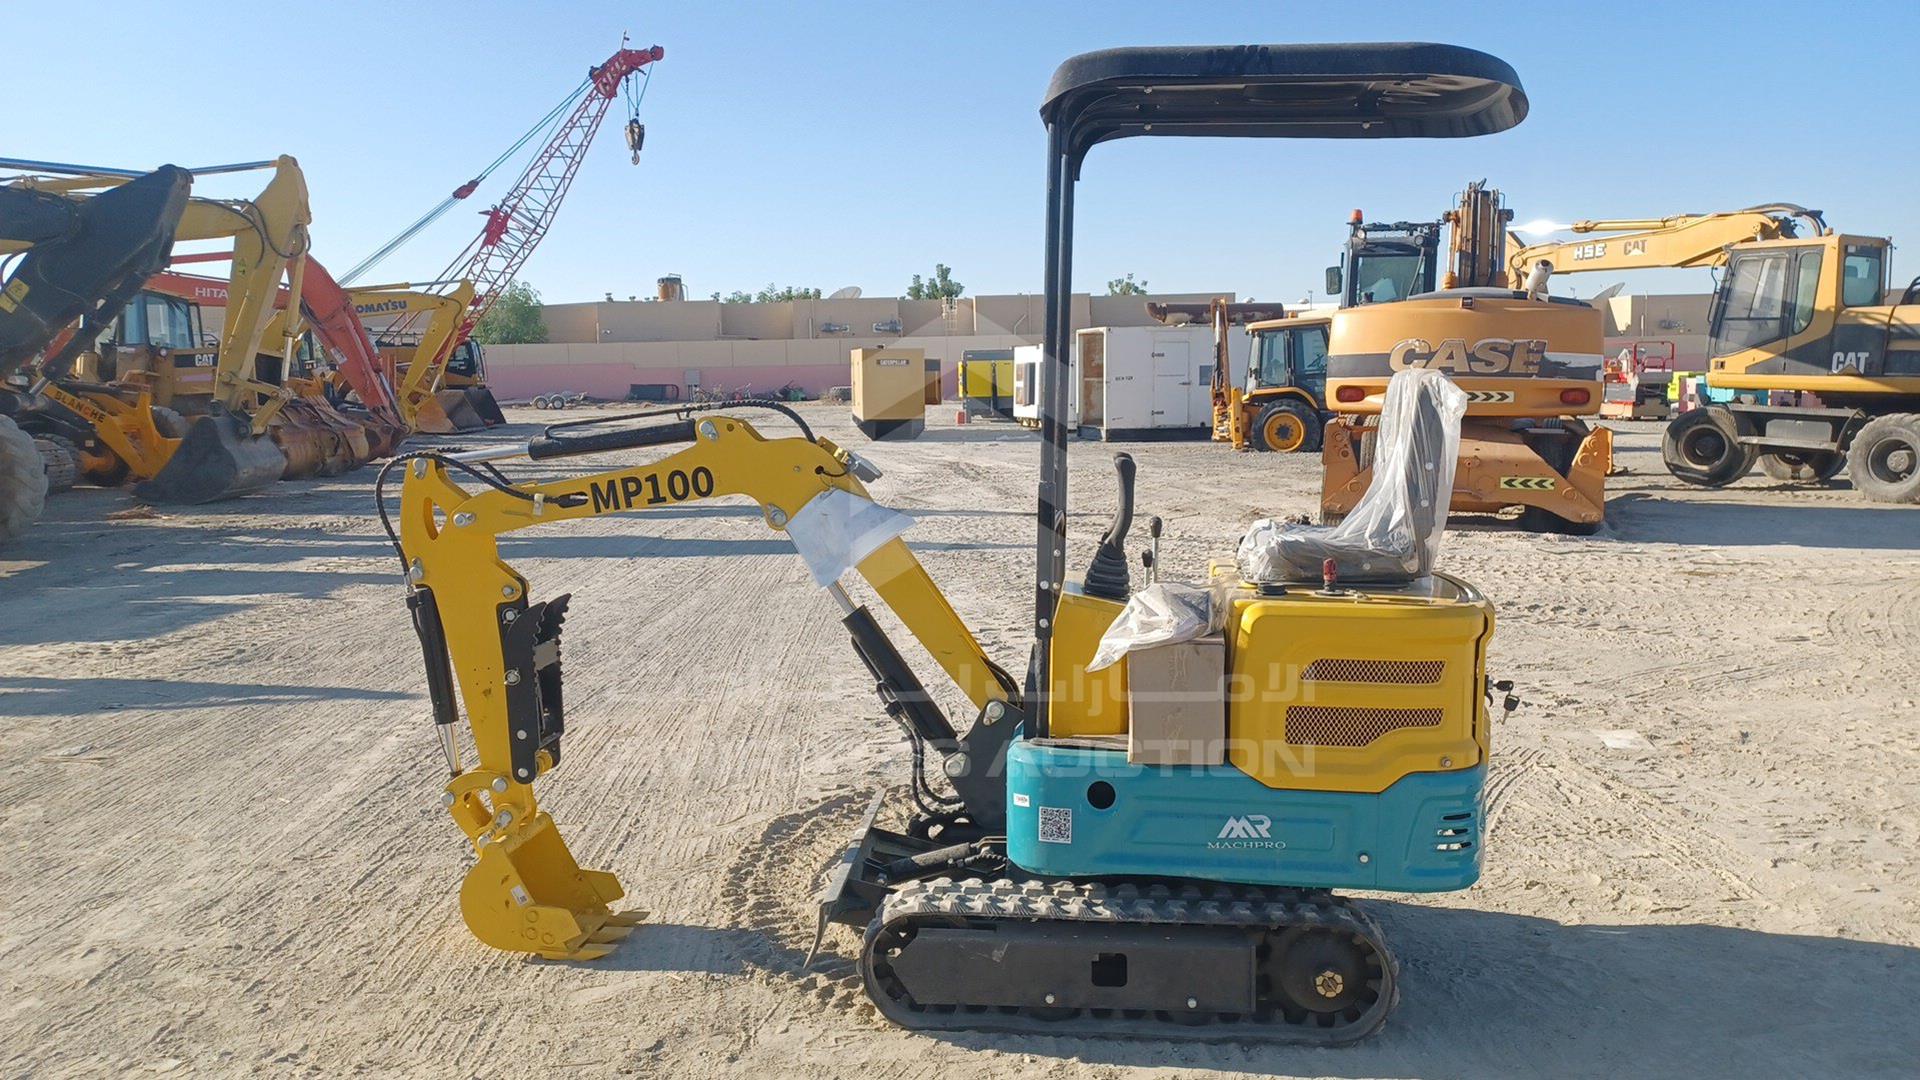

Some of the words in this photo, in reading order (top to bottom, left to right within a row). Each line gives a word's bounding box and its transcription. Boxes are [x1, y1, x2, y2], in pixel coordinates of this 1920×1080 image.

[1573, 242, 1607, 261] HSE
[1624, 240, 1647, 256] CAT
[195, 287, 229, 299] HITA
[356, 300, 407, 313] OMATSU
[195, 354, 214, 367] CAT
[1389, 338, 1548, 374] CASE
[1831, 351, 1870, 375] CAT
[590, 466, 714, 513] MP100
[1207, 841, 1287, 849] MACHPRO
